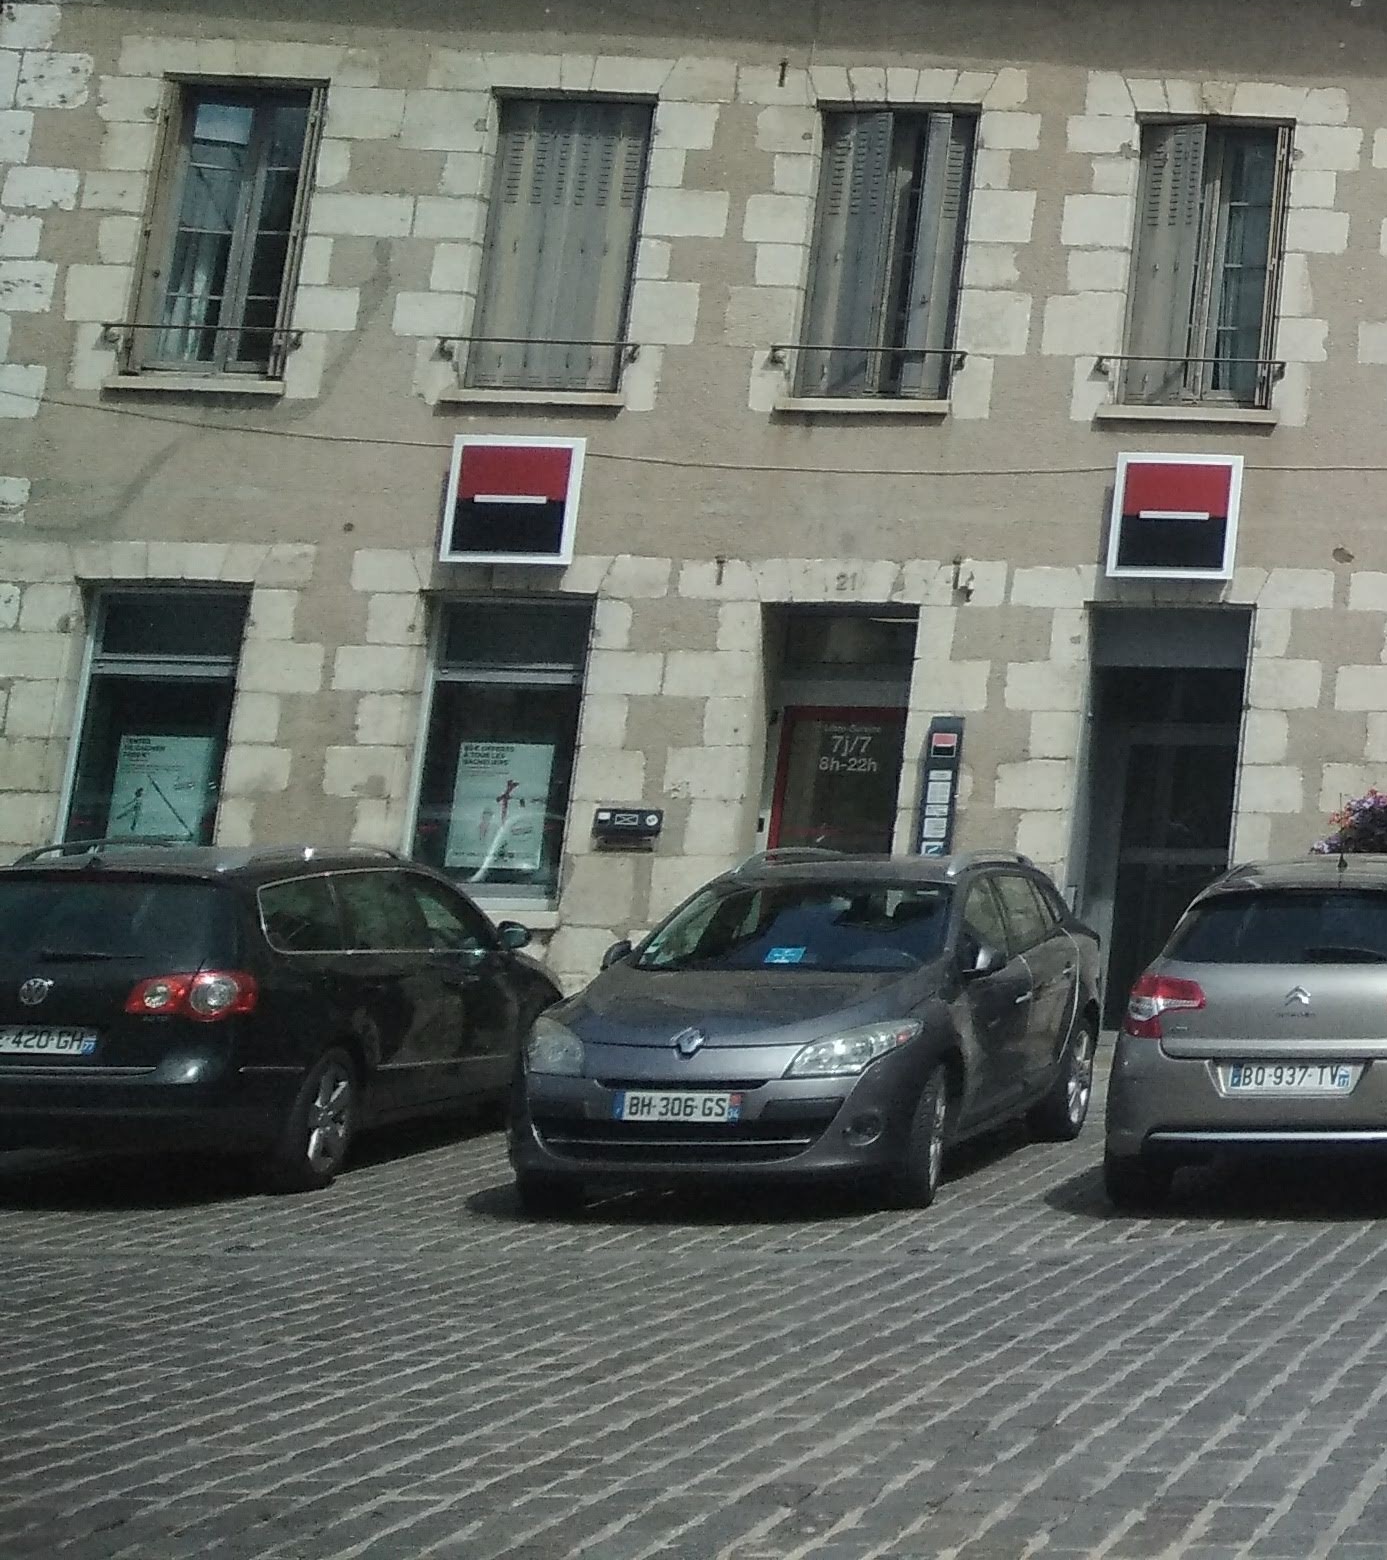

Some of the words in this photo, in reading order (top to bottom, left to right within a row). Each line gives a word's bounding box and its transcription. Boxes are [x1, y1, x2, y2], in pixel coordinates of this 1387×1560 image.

[832, 735, 872, 757] 7j/7
[818, 756, 877, 772] 8h-22h
[628, 1096, 727, 1117] BH-306-GS
